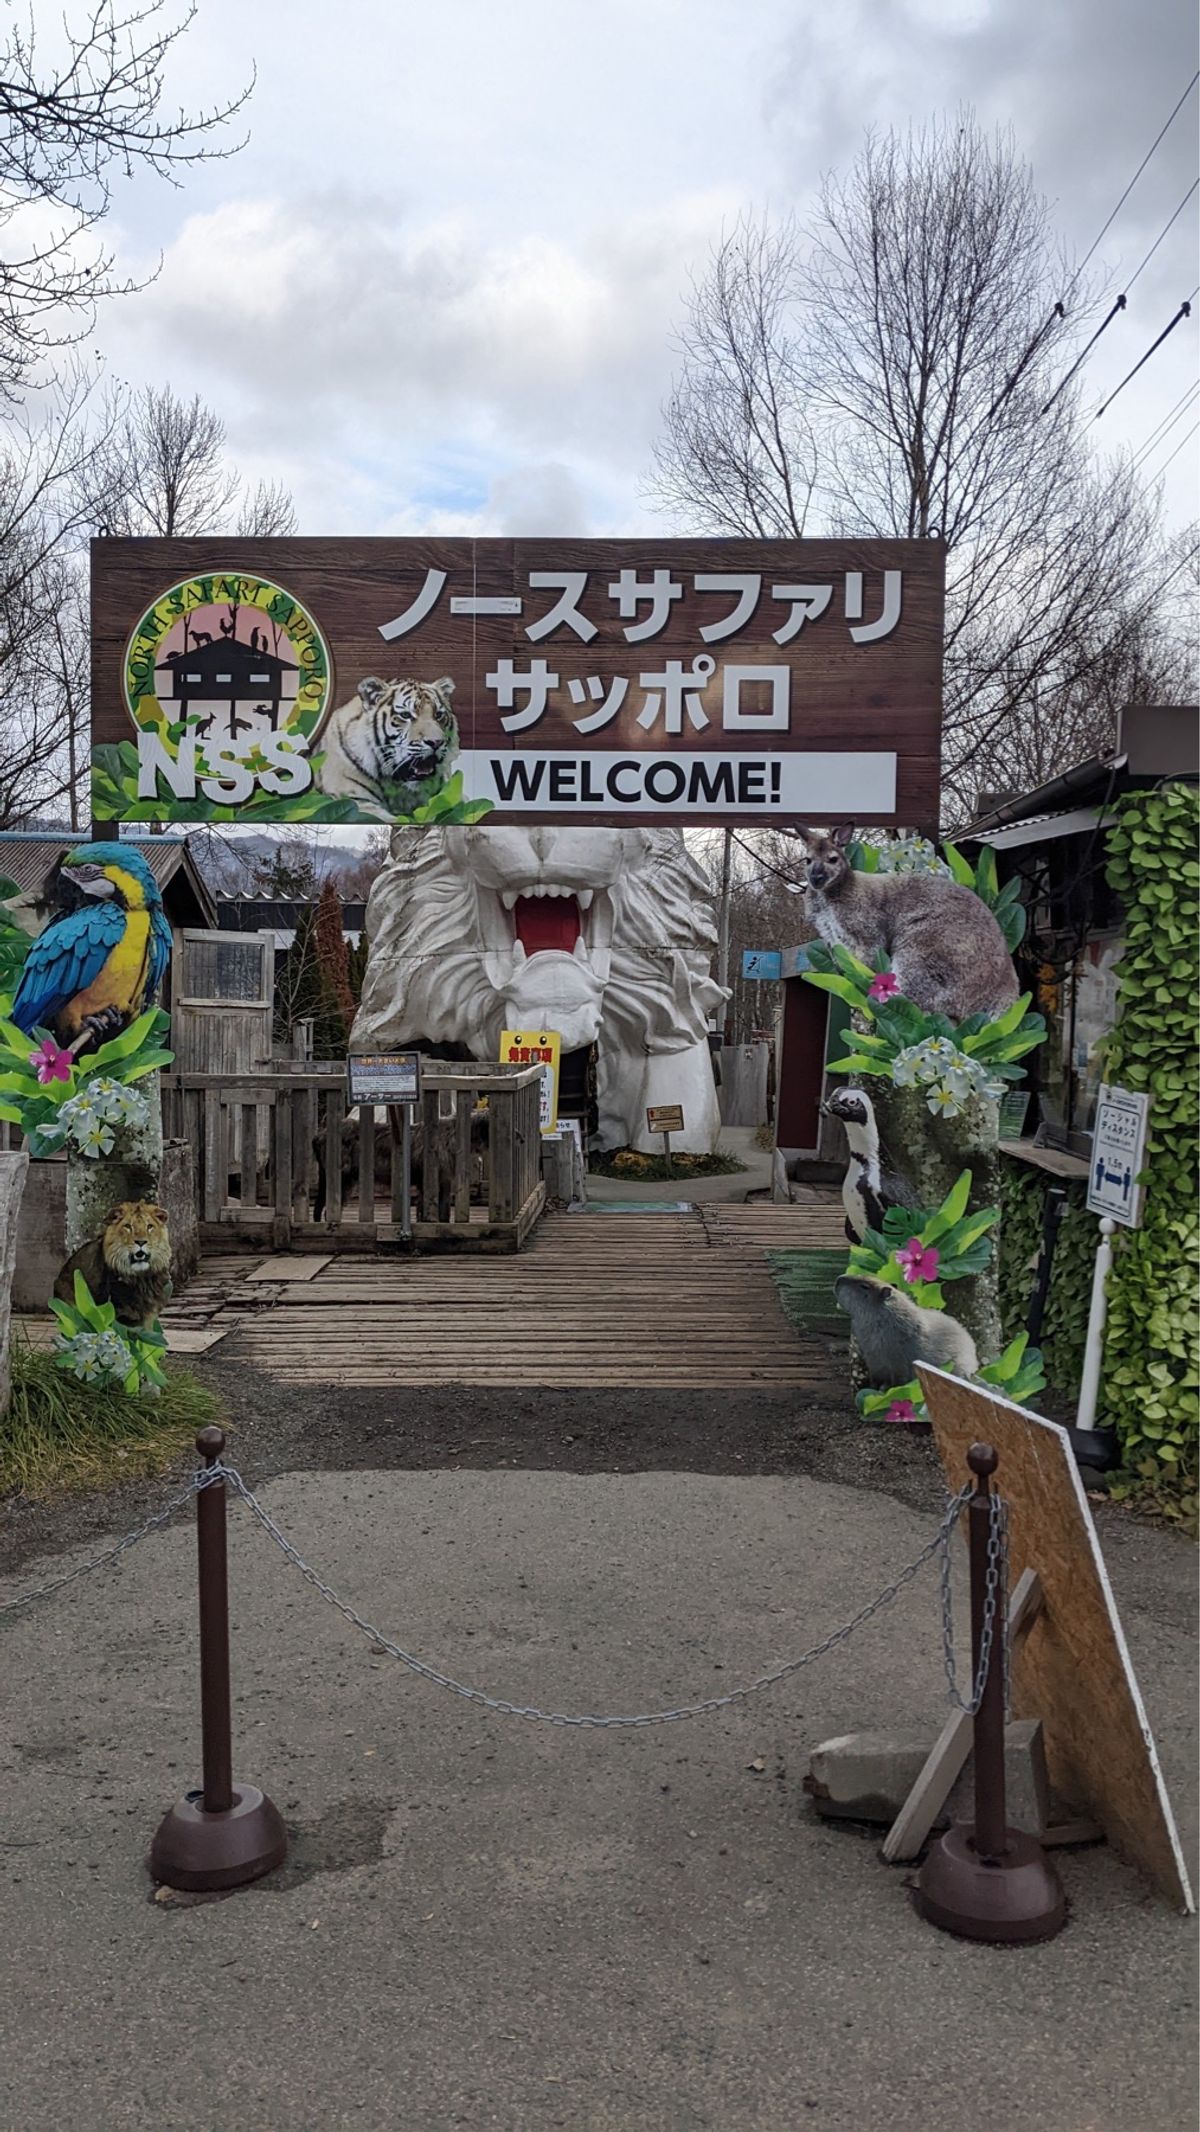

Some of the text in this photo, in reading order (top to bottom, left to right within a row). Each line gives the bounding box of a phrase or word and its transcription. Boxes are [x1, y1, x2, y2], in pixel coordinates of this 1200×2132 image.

[131, 578, 325, 700] NORTH SAFARI SAPPORO
[378, 568, 902, 645] ノースサファリ
[485, 653, 790, 734] サッポロ
[137, 728, 312, 804] NSS
[490, 759, 782, 803] WELCOME!
